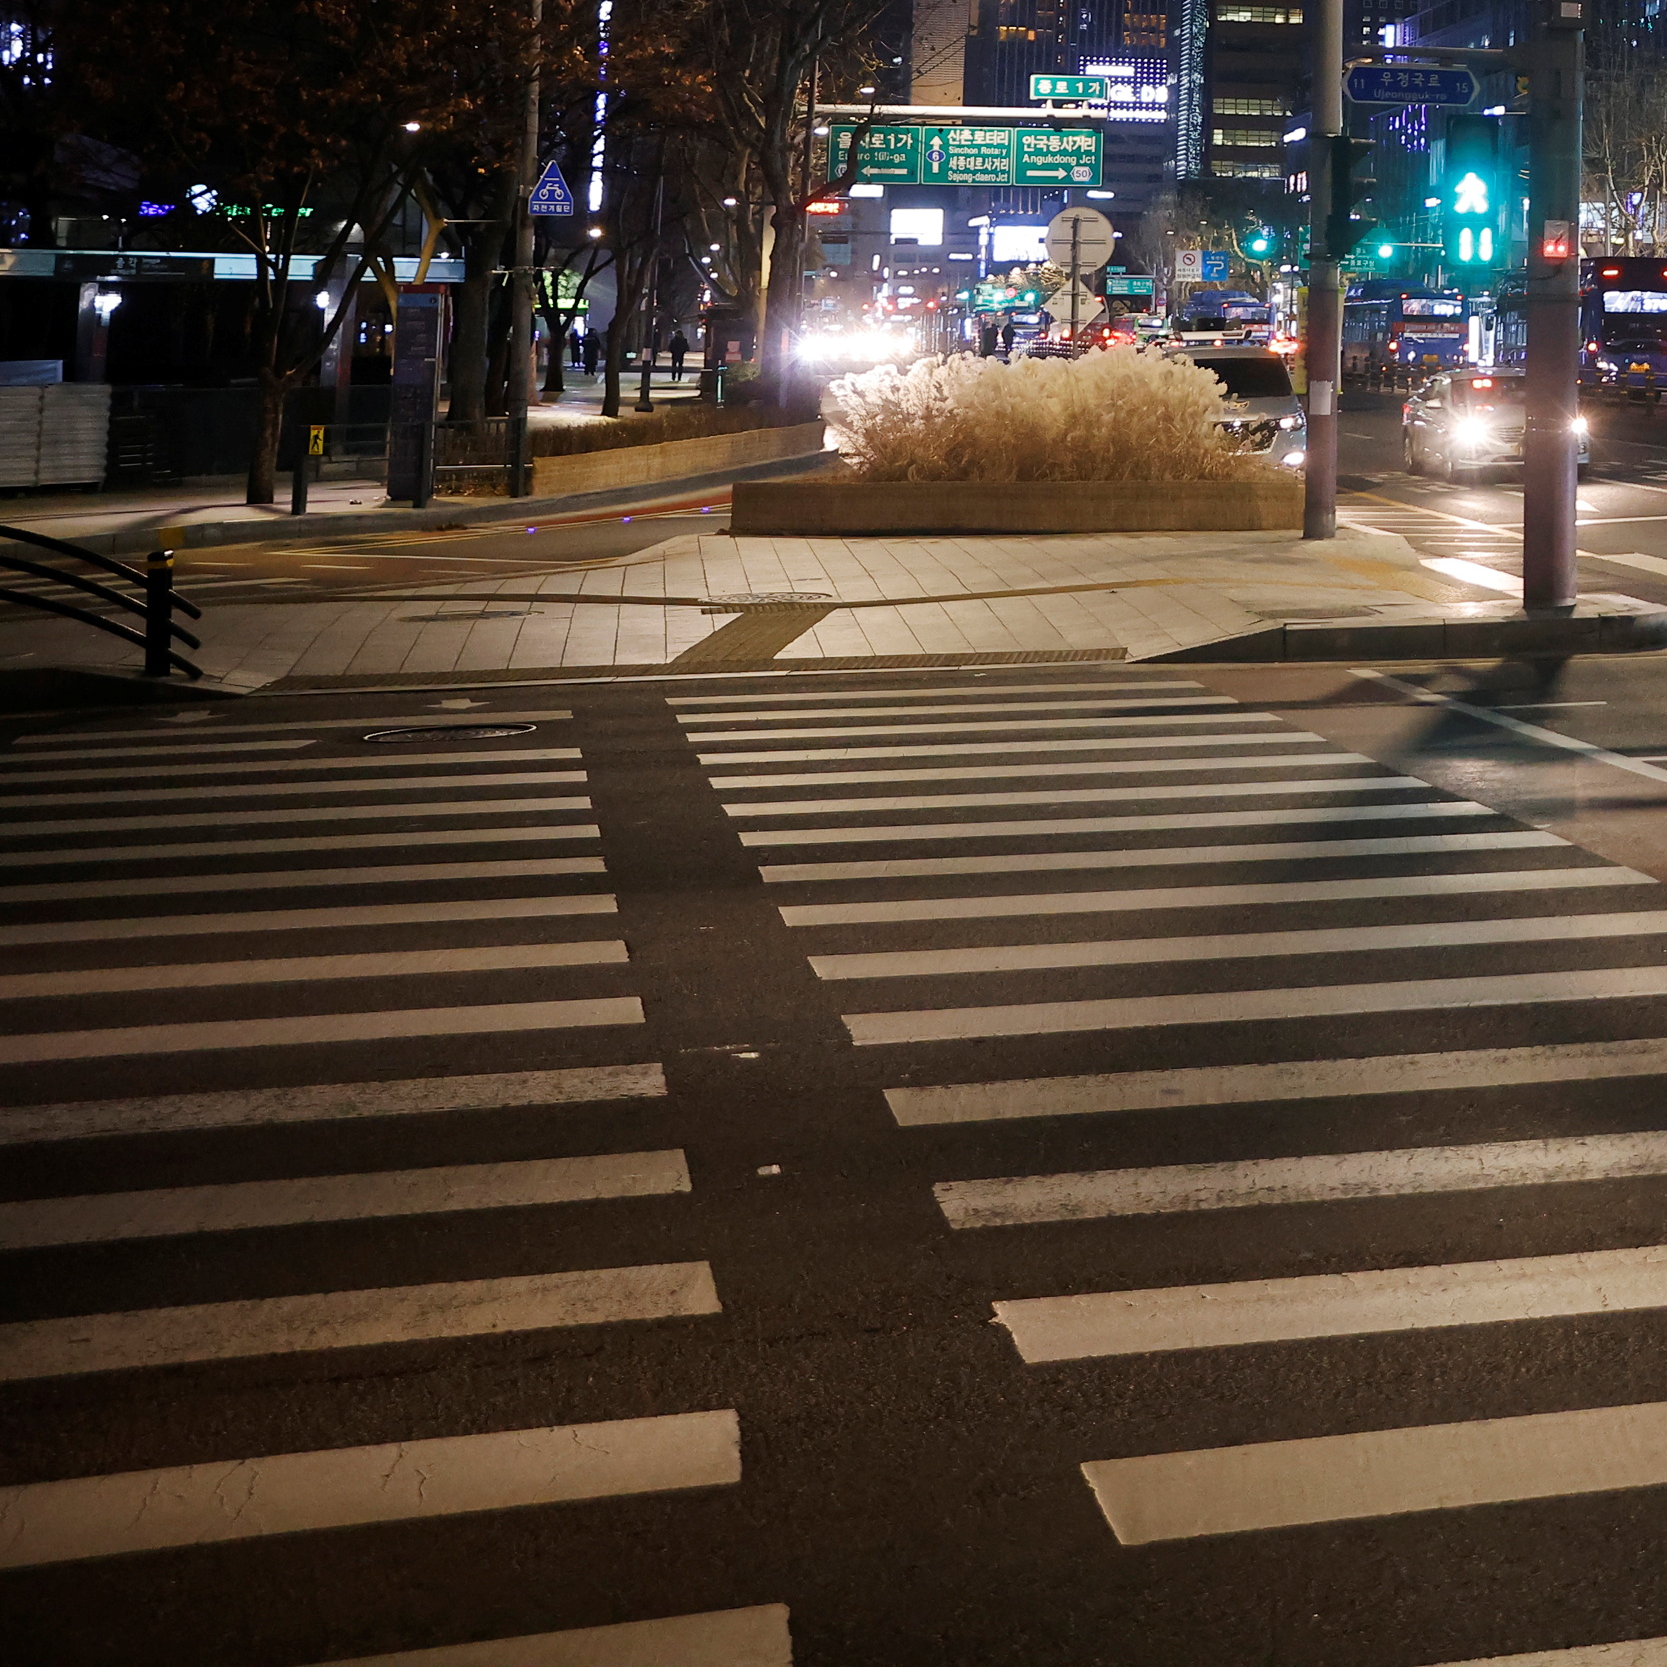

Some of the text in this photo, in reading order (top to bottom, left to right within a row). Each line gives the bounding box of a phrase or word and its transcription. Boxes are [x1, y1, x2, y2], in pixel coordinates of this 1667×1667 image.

[1037, 79, 1069, 95] 종로
[1354, 72, 1469, 93] 11 우정국로 15
[1373, 89, 1447, 102] Ujeongguk-ro
[947, 129, 1009, 145] 신촌로터리
[1022, 135, 1096, 152] 안국동사거리
[932, 151, 940, 161] 6
[948, 146, 1007, 156] Sinchon Rotary
[948, 156, 1009, 172] 세종대로사거리
[1022, 154, 1096, 166] Angukdong Jct
